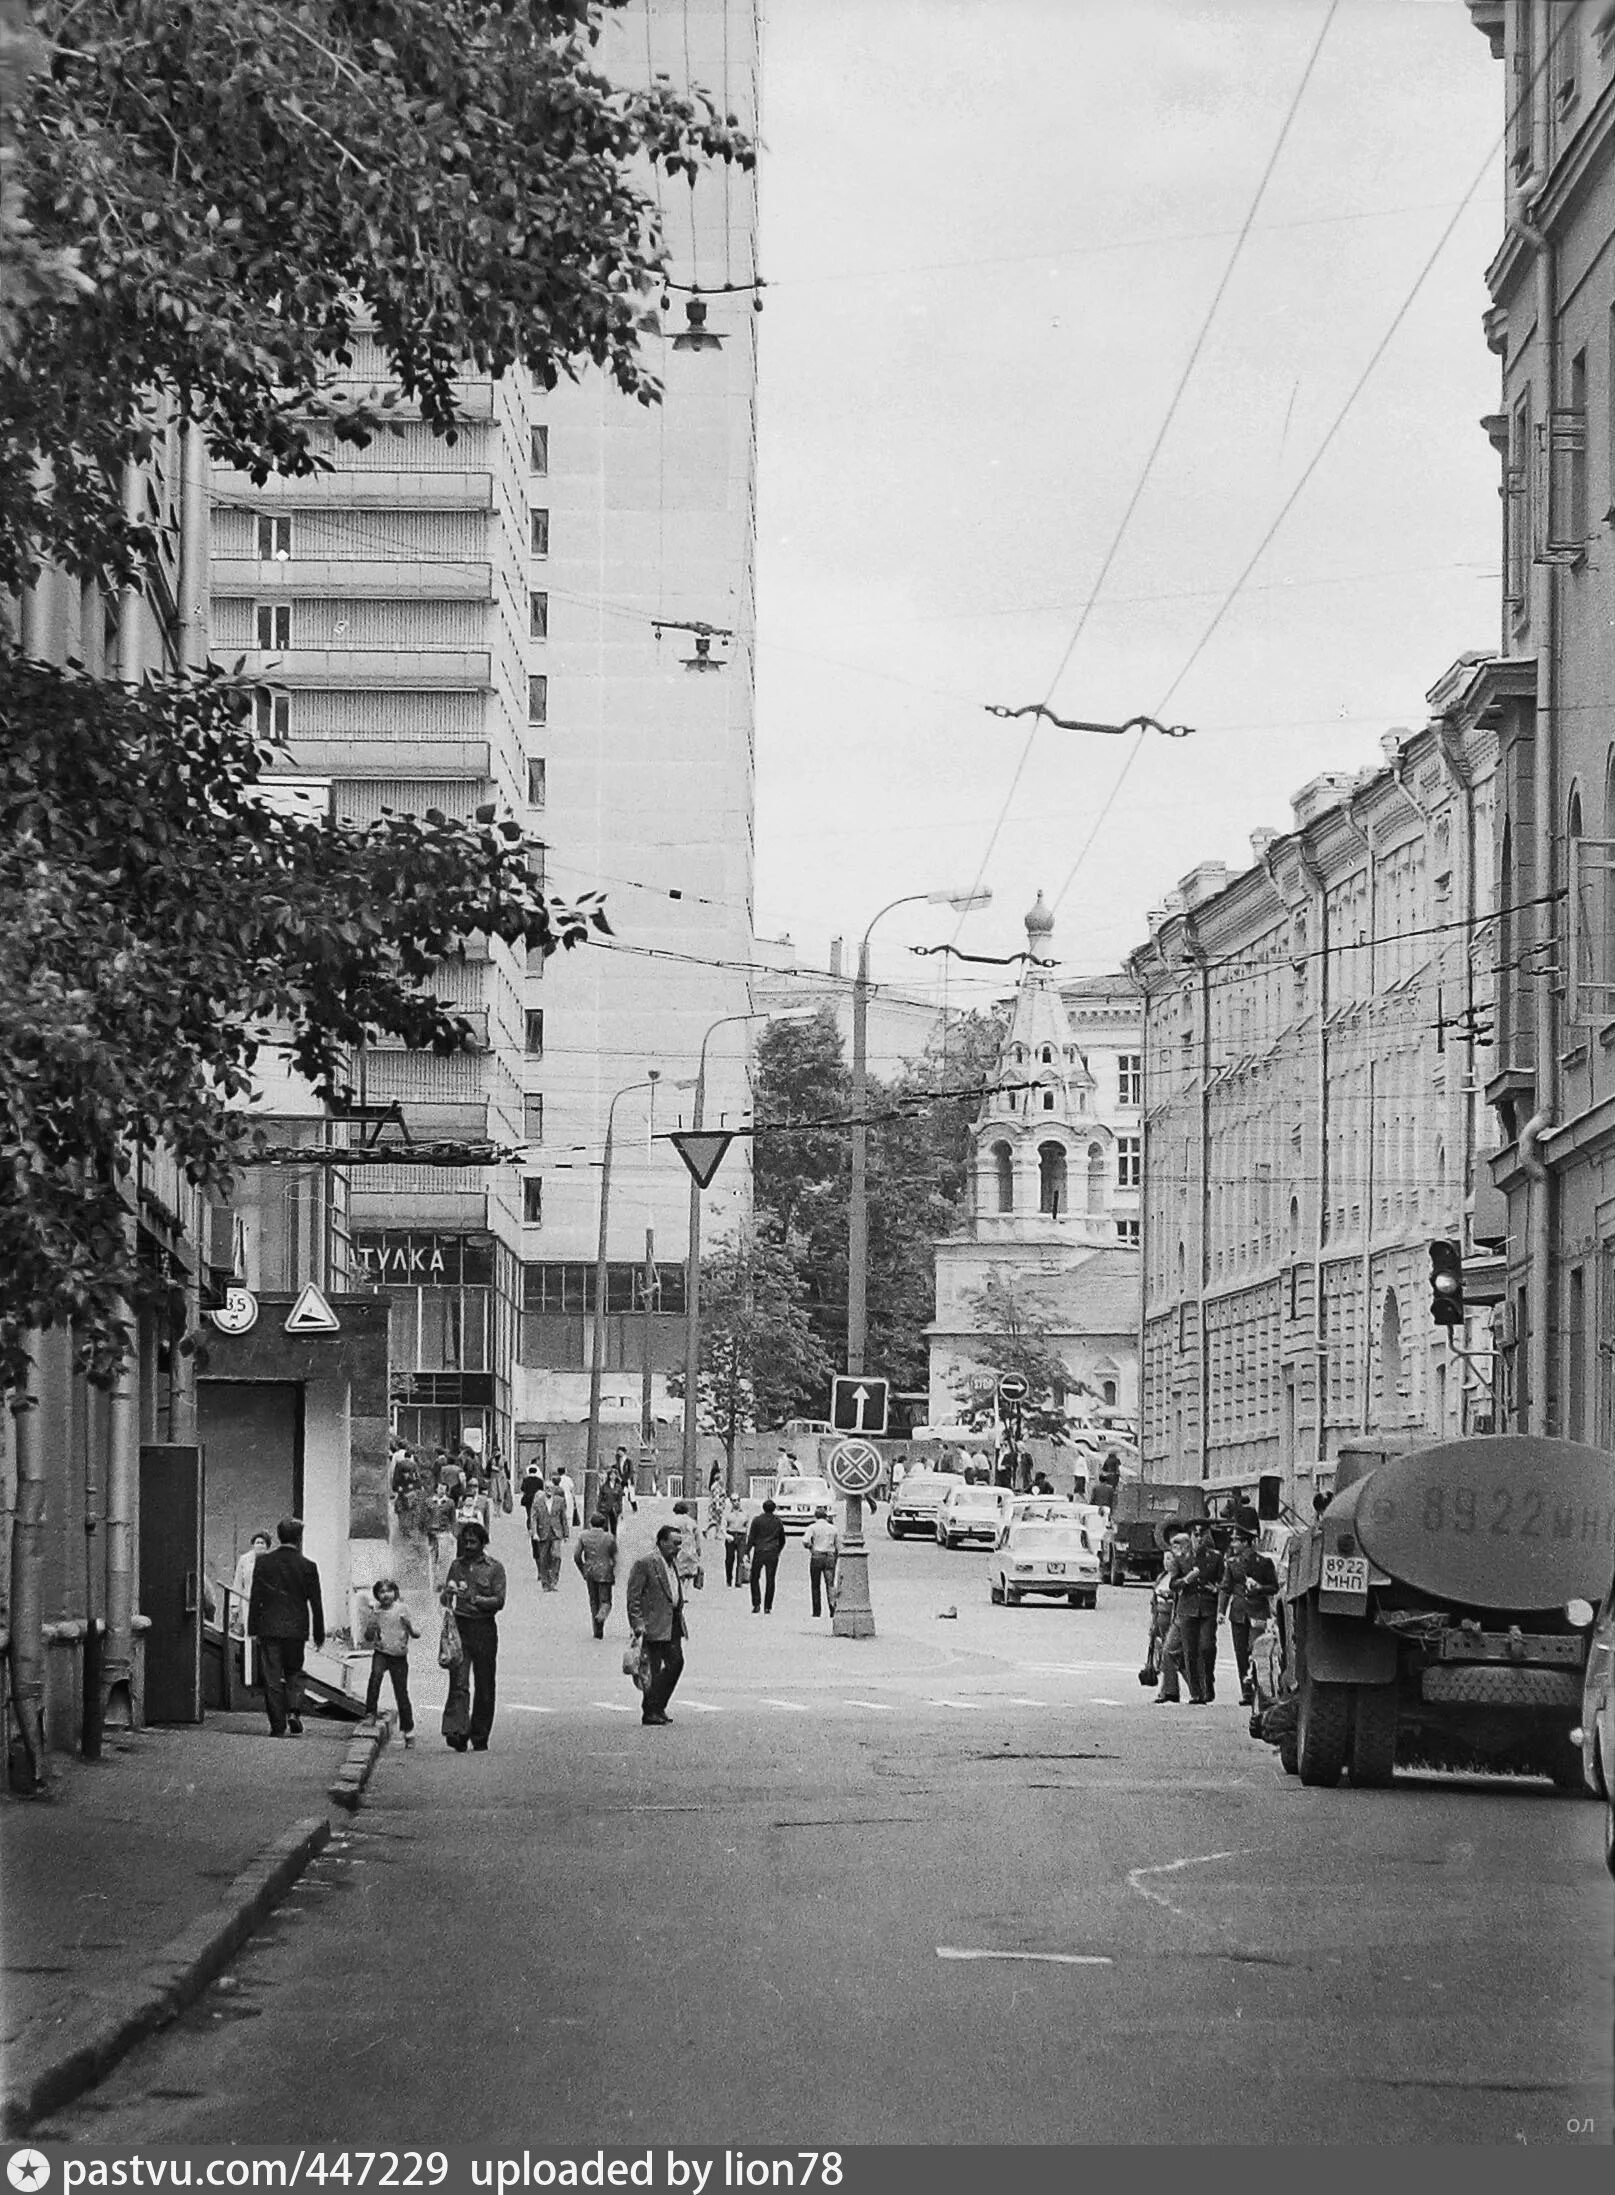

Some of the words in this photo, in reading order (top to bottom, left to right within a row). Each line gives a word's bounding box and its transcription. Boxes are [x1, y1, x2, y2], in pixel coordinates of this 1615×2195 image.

[1423, 1486, 1541, 1538] 8922
[1327, 1558, 1364, 1575] 8922
[1325, 1572, 1362, 1590] МНП
